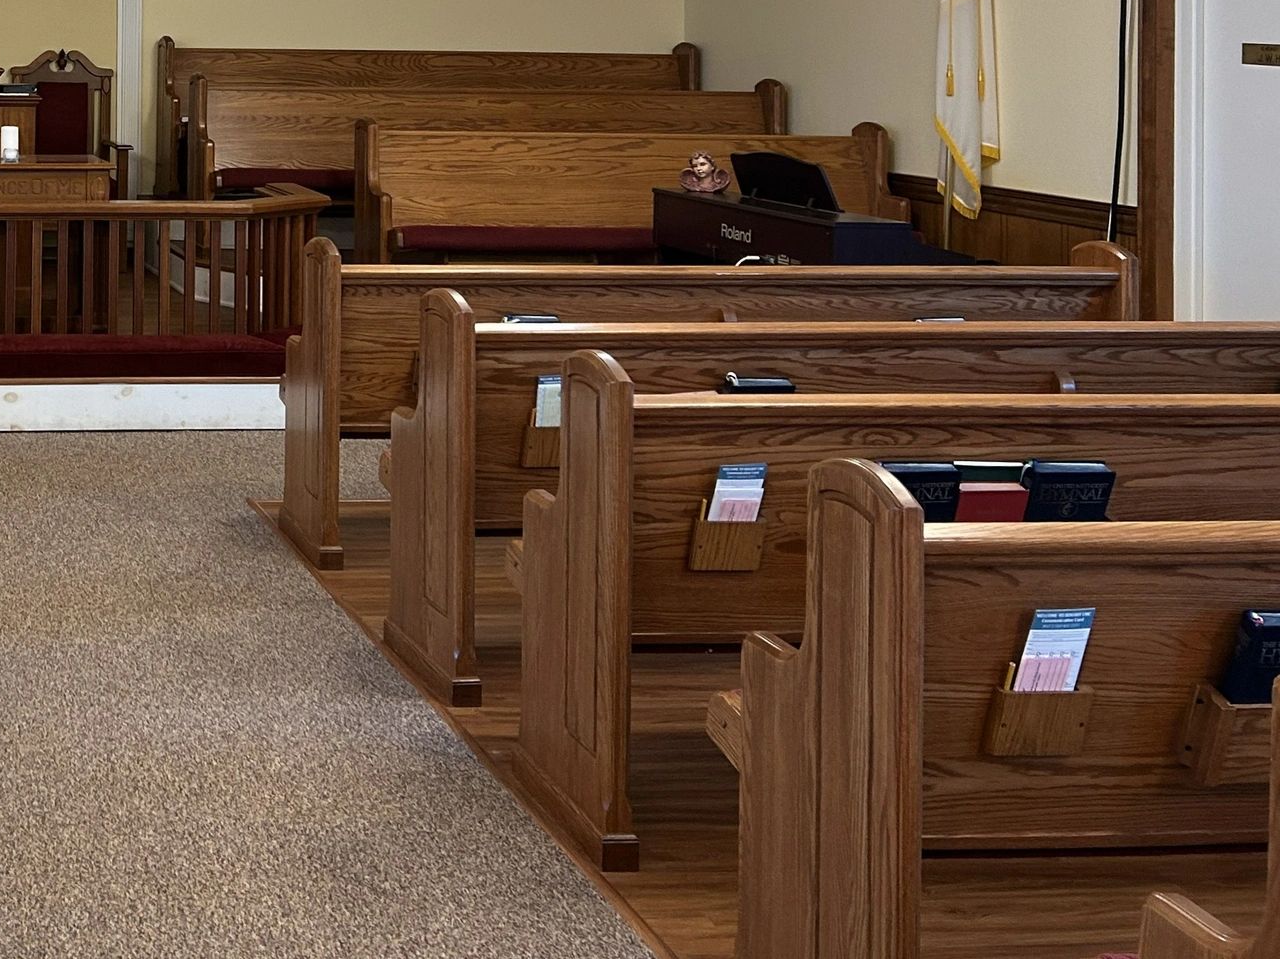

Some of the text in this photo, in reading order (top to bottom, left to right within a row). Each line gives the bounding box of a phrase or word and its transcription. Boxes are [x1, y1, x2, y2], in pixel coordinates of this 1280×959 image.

[56, 176, 82, 195] ME
[720, 223, 752, 244] Roland
[1040, 488, 1105, 501] HYMNAL
